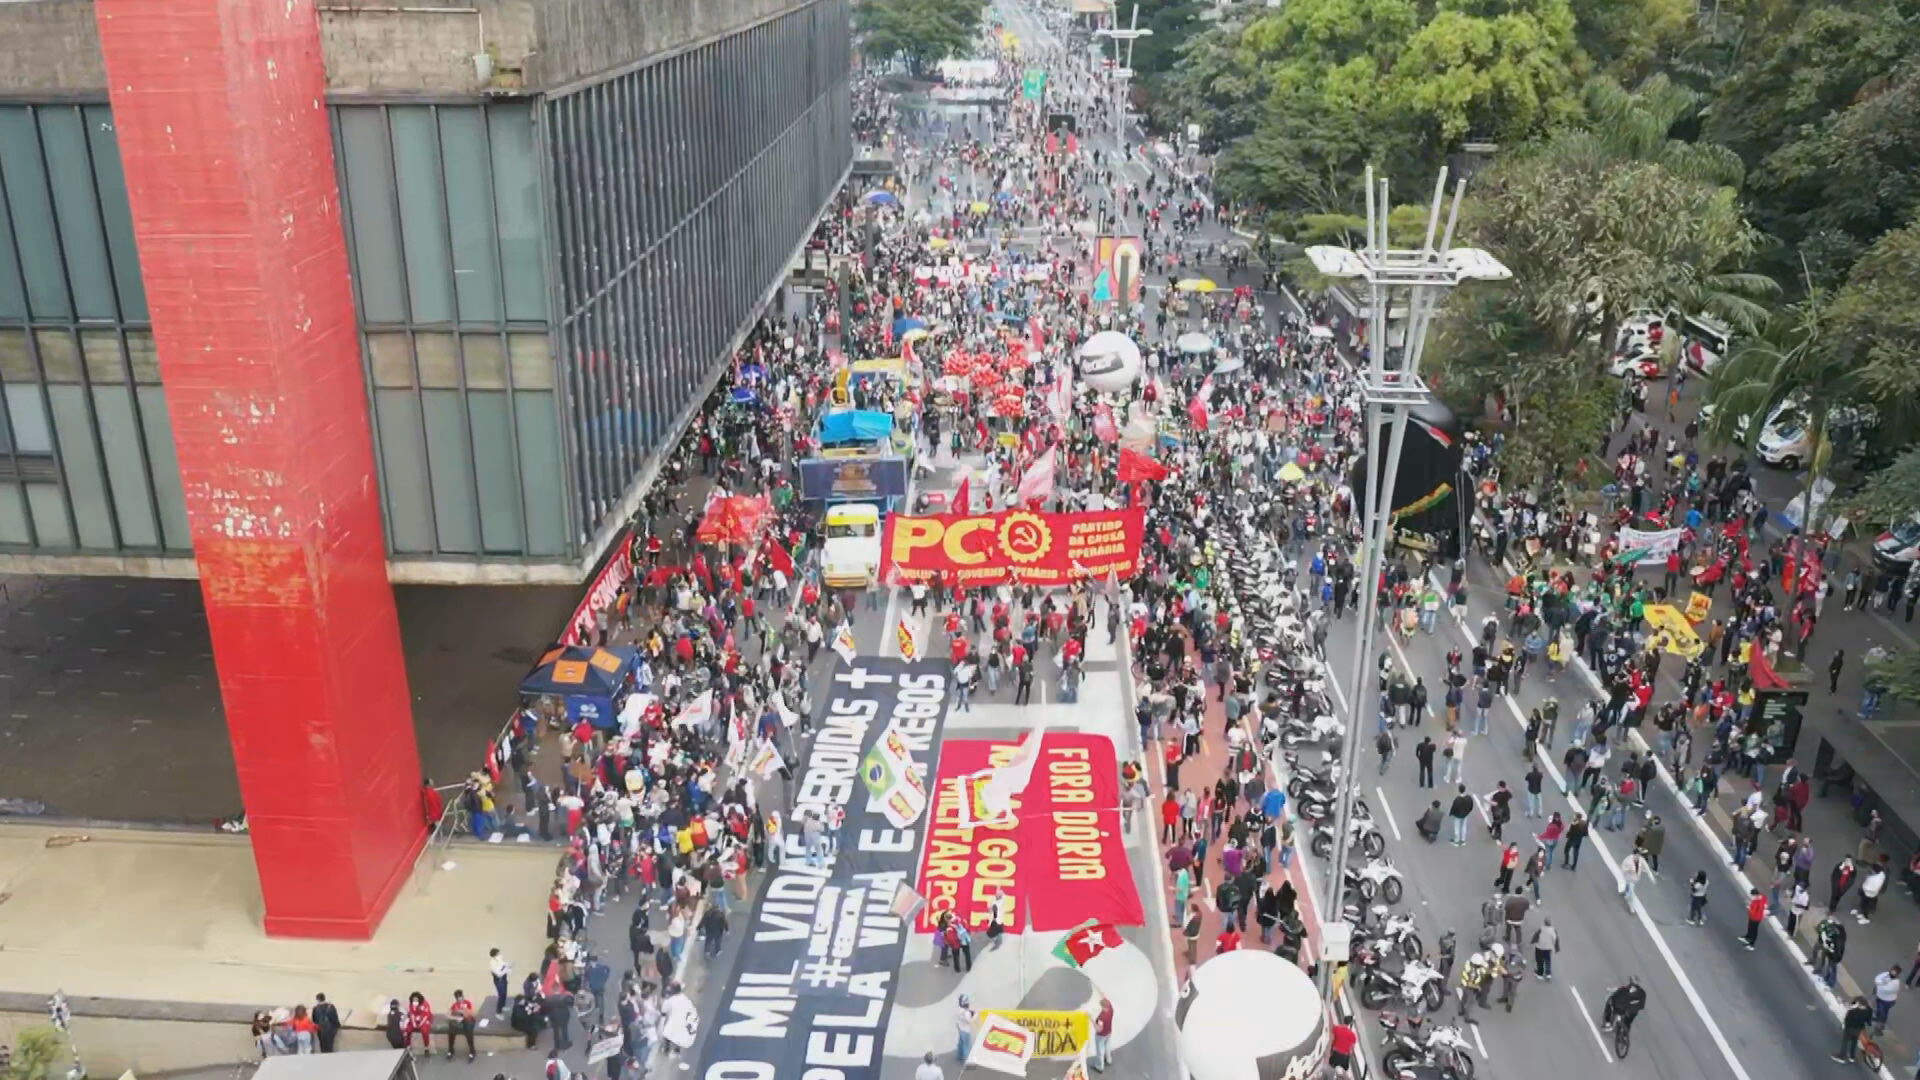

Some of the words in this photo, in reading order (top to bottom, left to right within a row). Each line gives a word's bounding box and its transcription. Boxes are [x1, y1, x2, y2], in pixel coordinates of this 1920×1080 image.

[1068, 535, 1085, 546] DA
[1086, 530, 1126, 544] CAUSA
[1072, 519, 1124, 535] PARTIDO
[1014, 567, 1058, 578] PERÁRIO
[791, 698, 879, 821] PERDIDAS
[1047, 747, 1094, 803] FORA
[858, 828, 915, 852] E
[926, 778, 974, 878] MILITAR
[1052, 811, 1109, 880] DÓRIA
[755, 833, 837, 942] VIDAS
[969, 838, 1019, 928] GOLPE
[719, 959, 799, 1038] MIL
